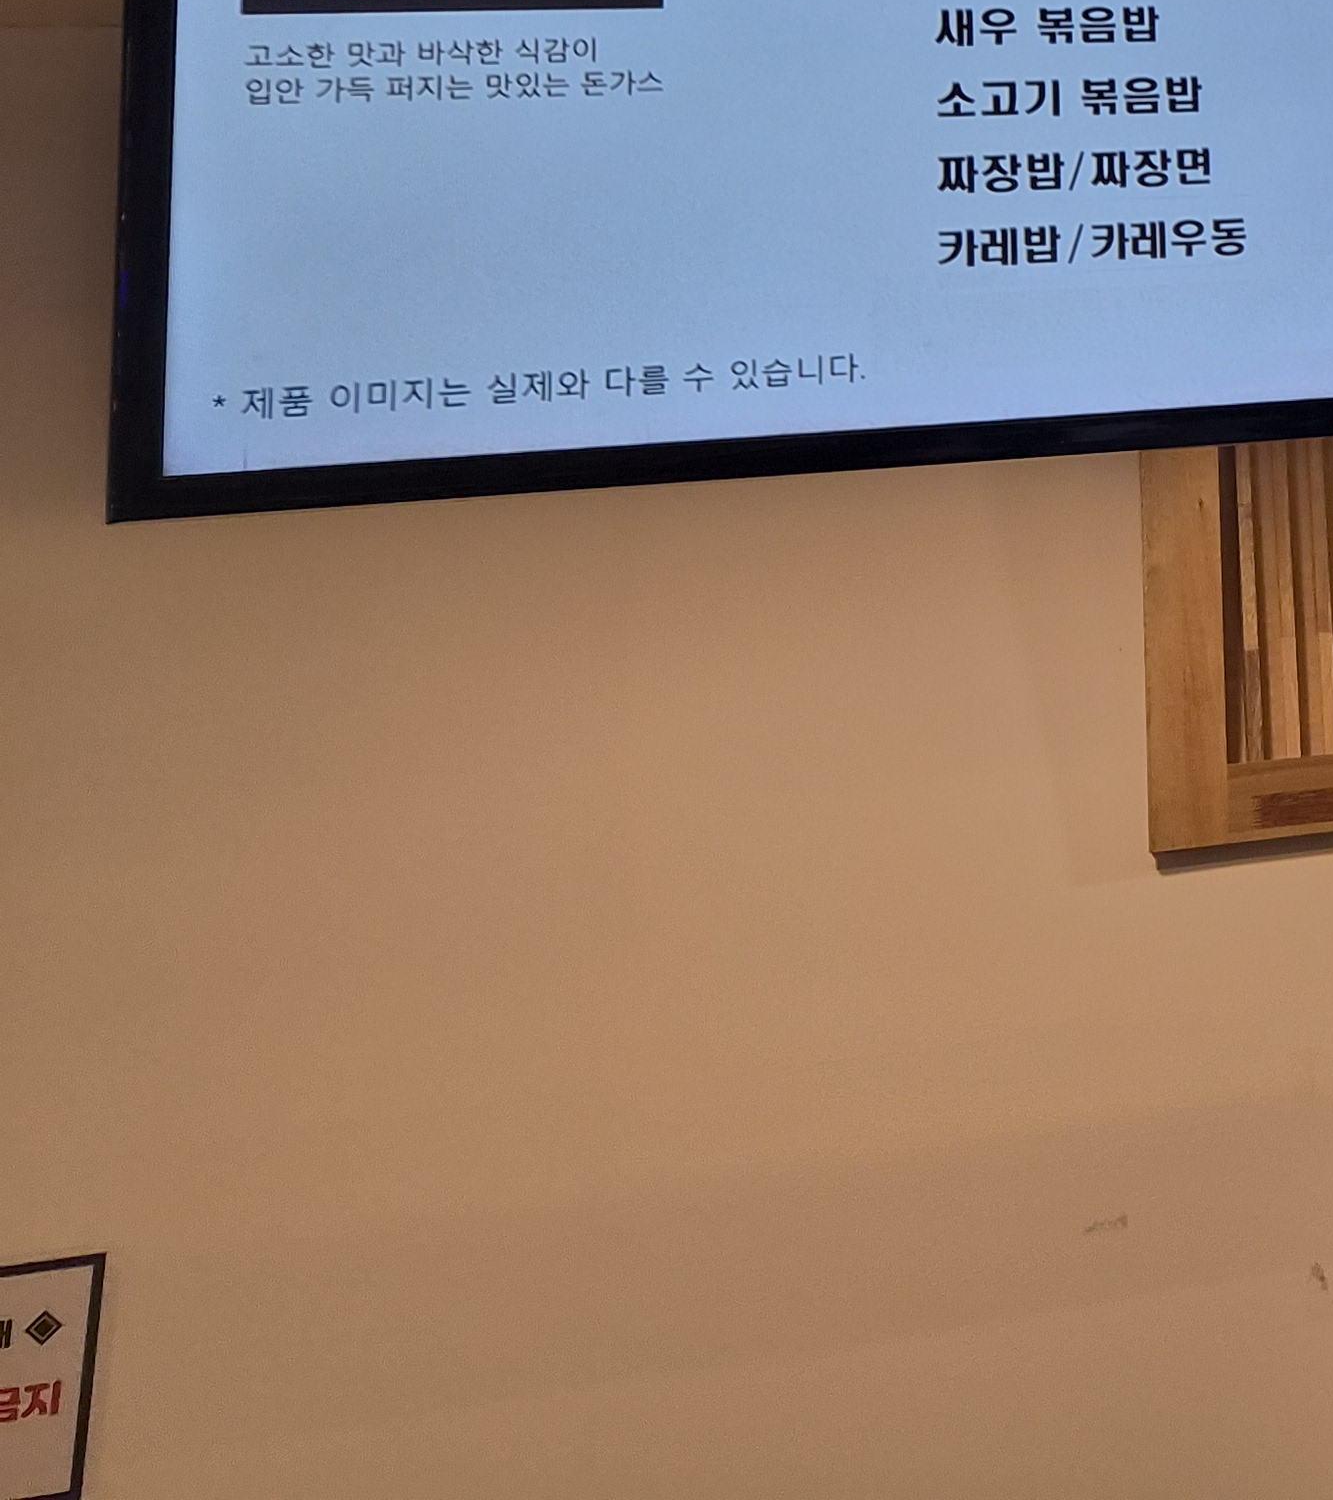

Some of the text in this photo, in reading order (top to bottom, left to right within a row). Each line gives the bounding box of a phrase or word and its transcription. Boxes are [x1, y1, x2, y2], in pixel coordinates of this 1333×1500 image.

[936, 9, 1016, 46] 새우
[1038, 7, 1159, 44] 볶음밥
[245, 38, 596, 68] 고소한 맛과 바삭한 식감이
[246, 70, 663, 105] 입안 가득 퍼지는 맛있는 돈가스
[938, 80, 1060, 117] 소고기
[1082, 77, 1202, 115] 볶음밥
[938, 148, 1210, 193] 짜장밥/짜장면
[243, 354, 865, 419] 제품 이미지는 실제와 다를 수 있습니다.
